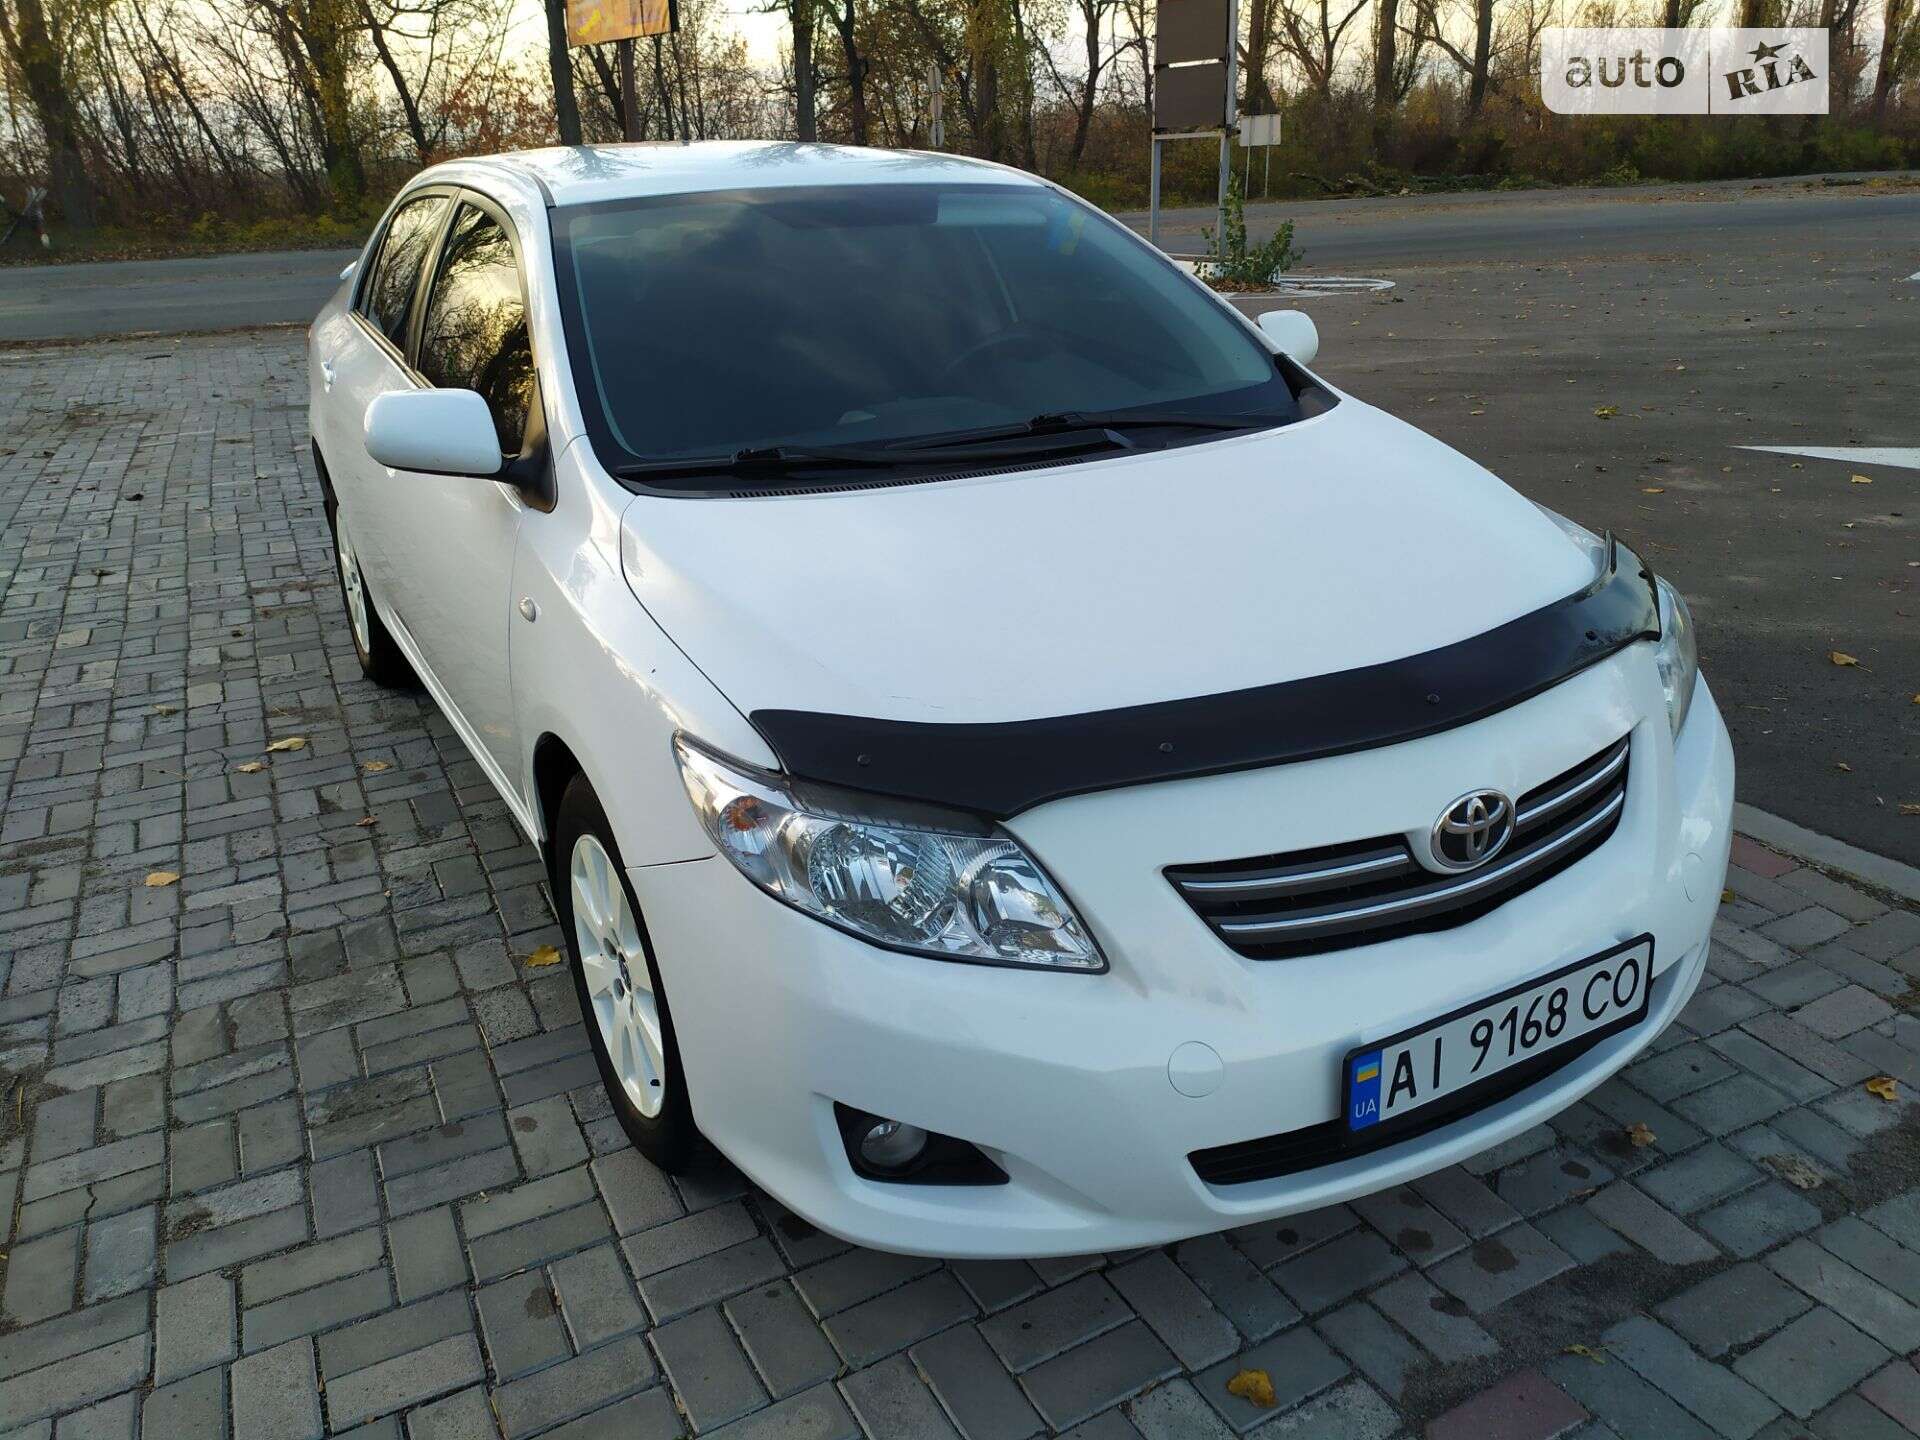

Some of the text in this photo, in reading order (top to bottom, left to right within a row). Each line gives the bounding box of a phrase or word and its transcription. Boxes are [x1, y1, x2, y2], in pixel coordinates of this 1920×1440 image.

[1387, 958, 1640, 1108] AI 9168 CO
[1355, 1098, 1377, 1118] UA
